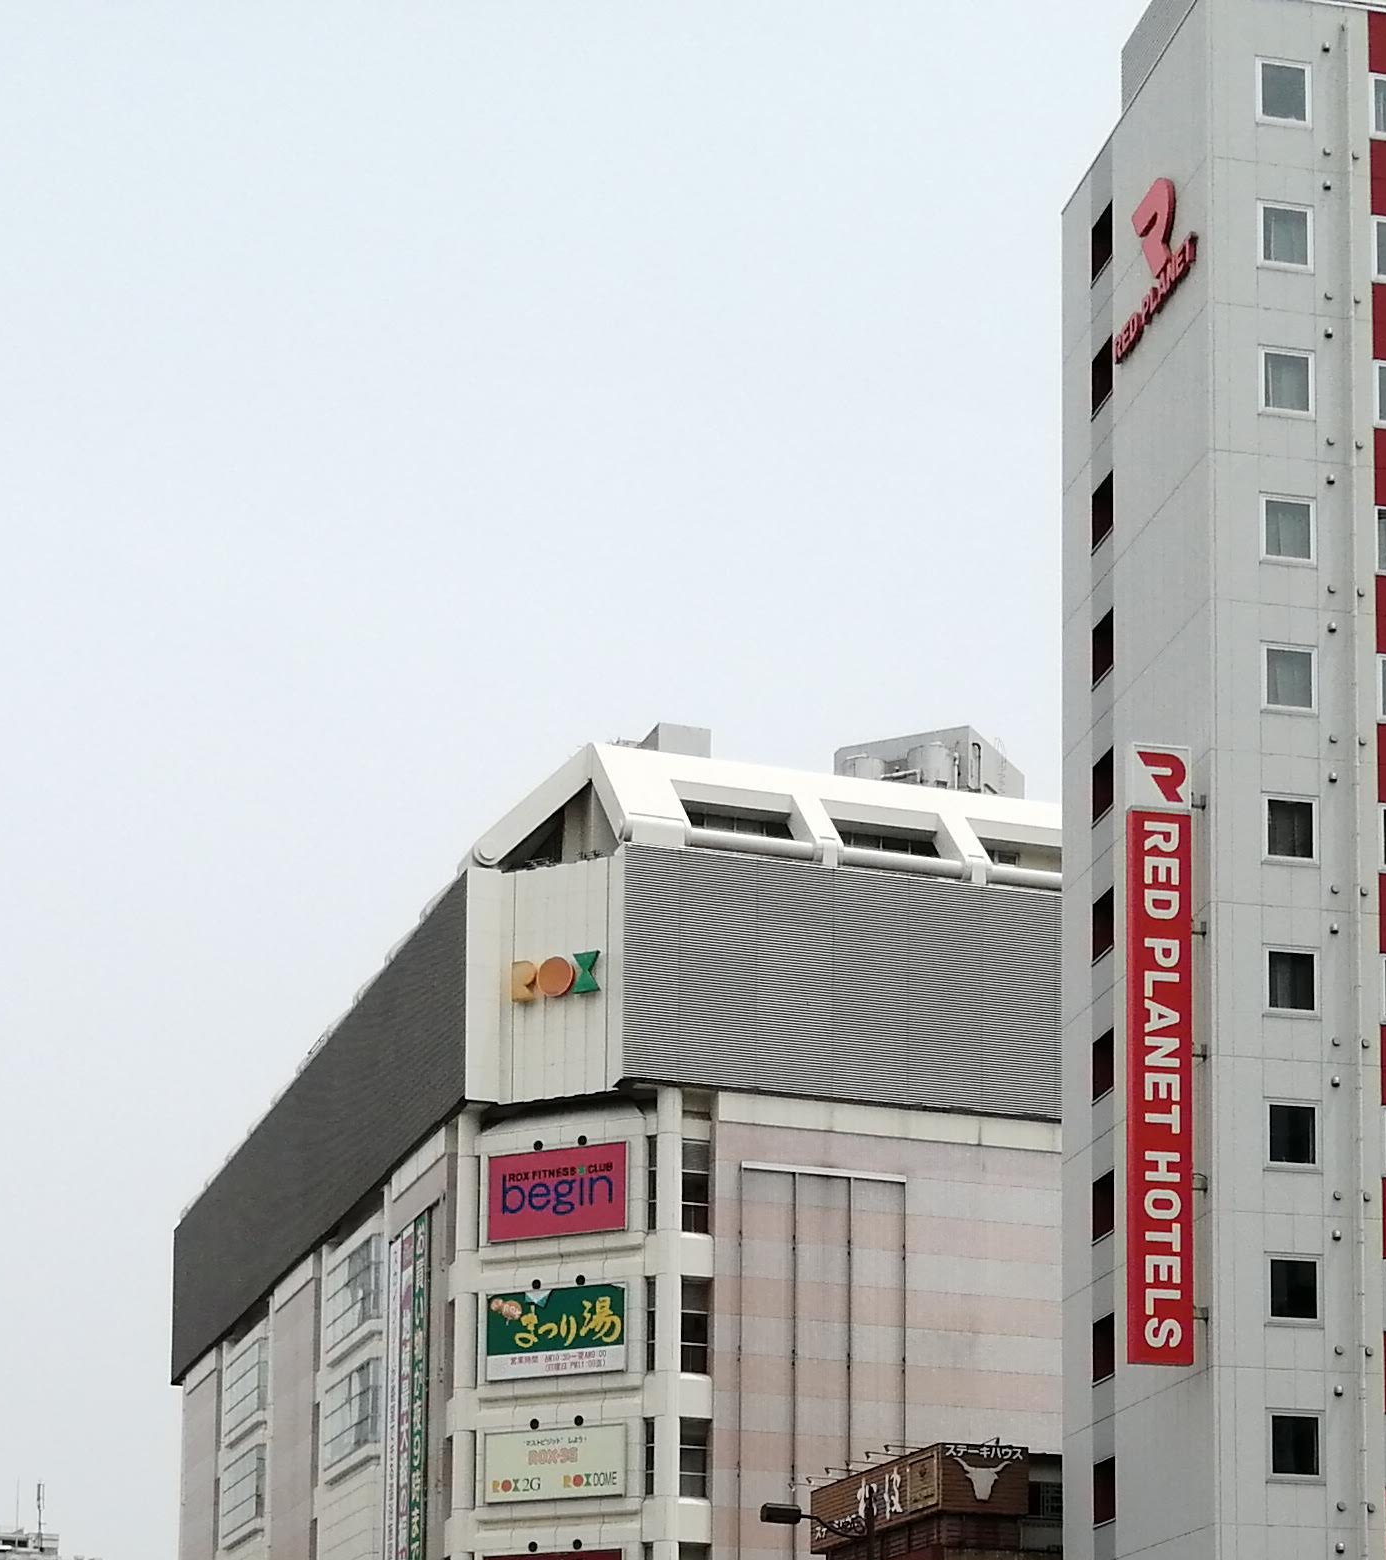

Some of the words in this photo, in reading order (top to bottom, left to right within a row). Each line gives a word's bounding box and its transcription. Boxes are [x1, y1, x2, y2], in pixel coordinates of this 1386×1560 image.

[1114, 311, 1142, 363] RED
[1140, 231, 1197, 325] PLANET
[1144, 820, 1180, 920] RED
[511, 950, 600, 1003] ROX
[1144, 937, 1181, 1135] PLANET
[502, 1173, 613, 1215] begin
[508, 1172, 529, 1182] ROX
[532, 1167, 577, 1180] FITNESS
[588, 1162, 613, 1174] CLUB
[1144, 1150, 1182, 1349] HOTELS
[514, 1296, 622, 1348] まつり湯
[593, 1471, 617, 1486] DOME
[945, 1445, 1023, 1460] ステーキハウス
